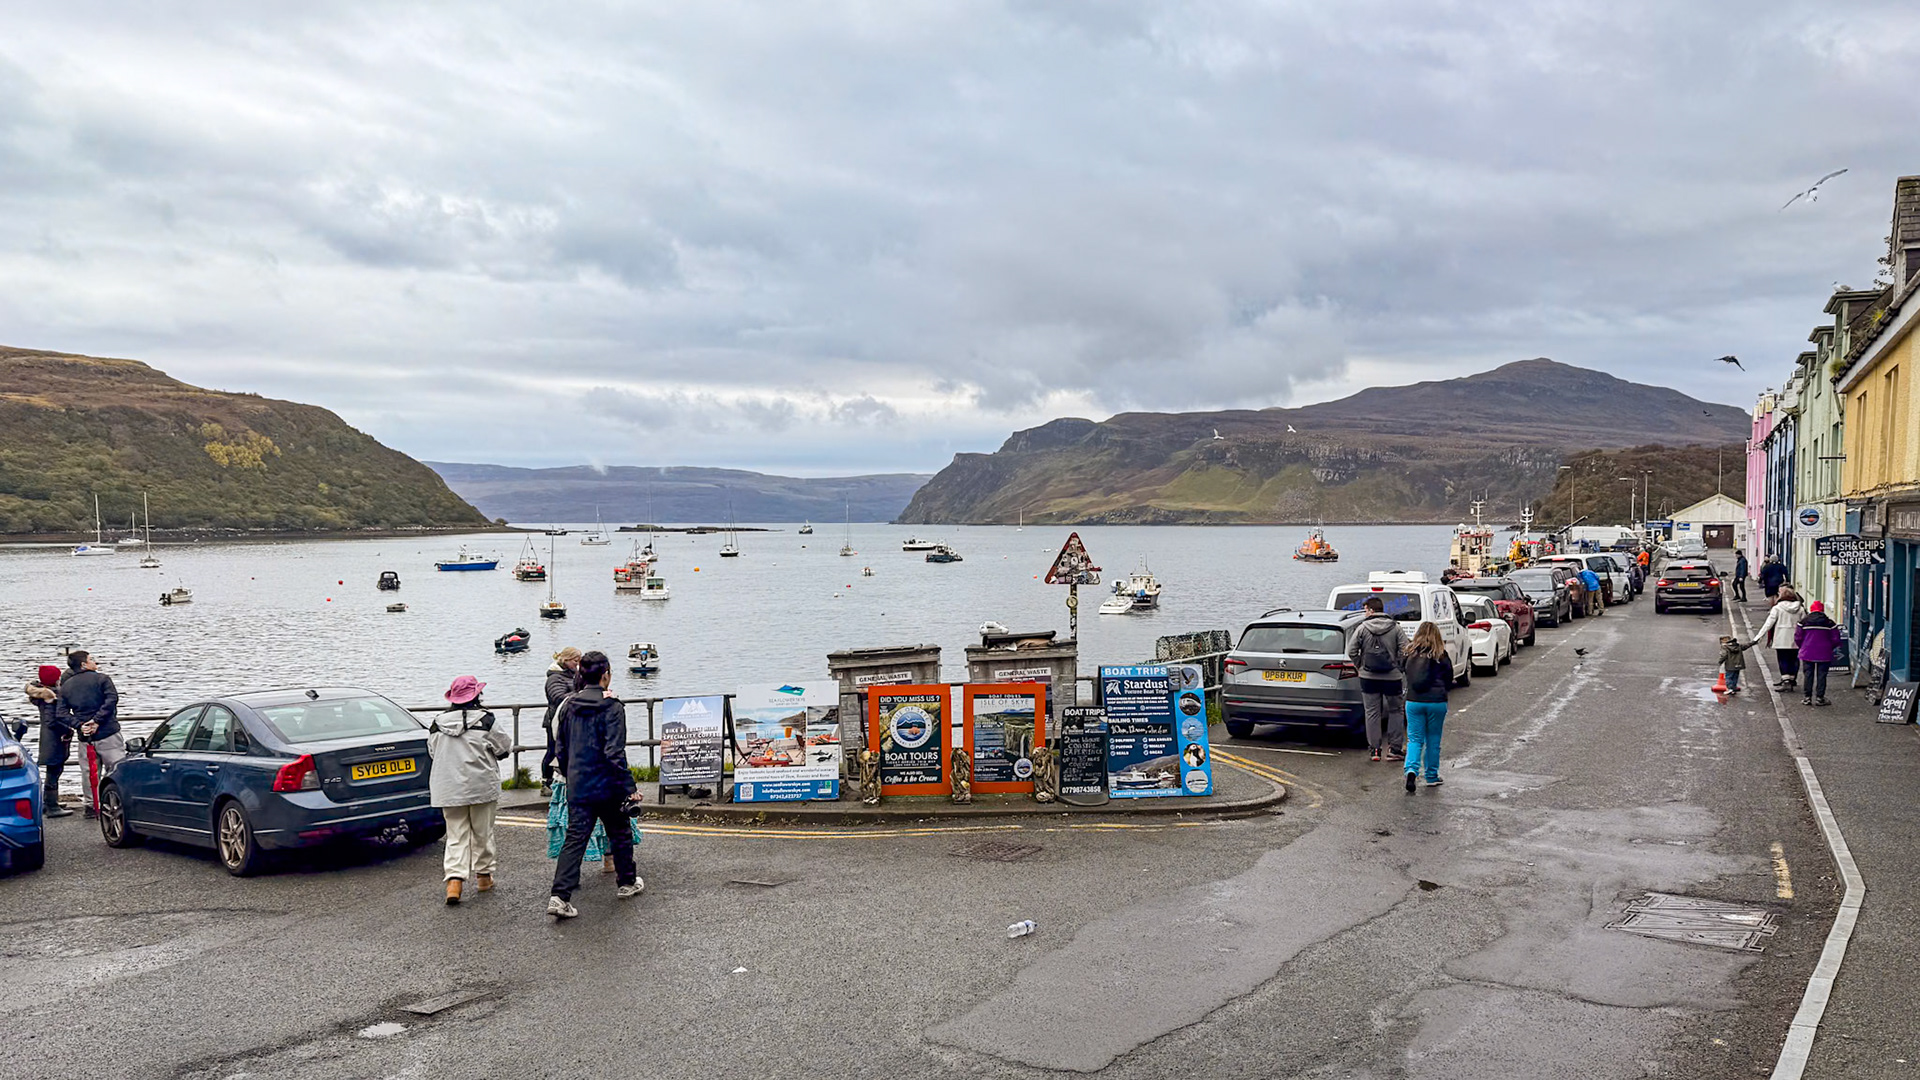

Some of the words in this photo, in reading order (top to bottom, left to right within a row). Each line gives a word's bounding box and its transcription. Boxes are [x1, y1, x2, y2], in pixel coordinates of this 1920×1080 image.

[1832, 540, 1885, 551] FISH&CHIPS
[1286, 671, 1303, 679] KUR
[1124, 680, 1168, 689] Stardust
[893, 711, 902, 722] ISLE
[917, 708, 928, 720] SKYE
[909, 752, 938, 760] TOURS
[356, 763, 387, 777] SY08
[390, 760, 411, 772] OLB
[885, 776, 902, 784] Coffee
